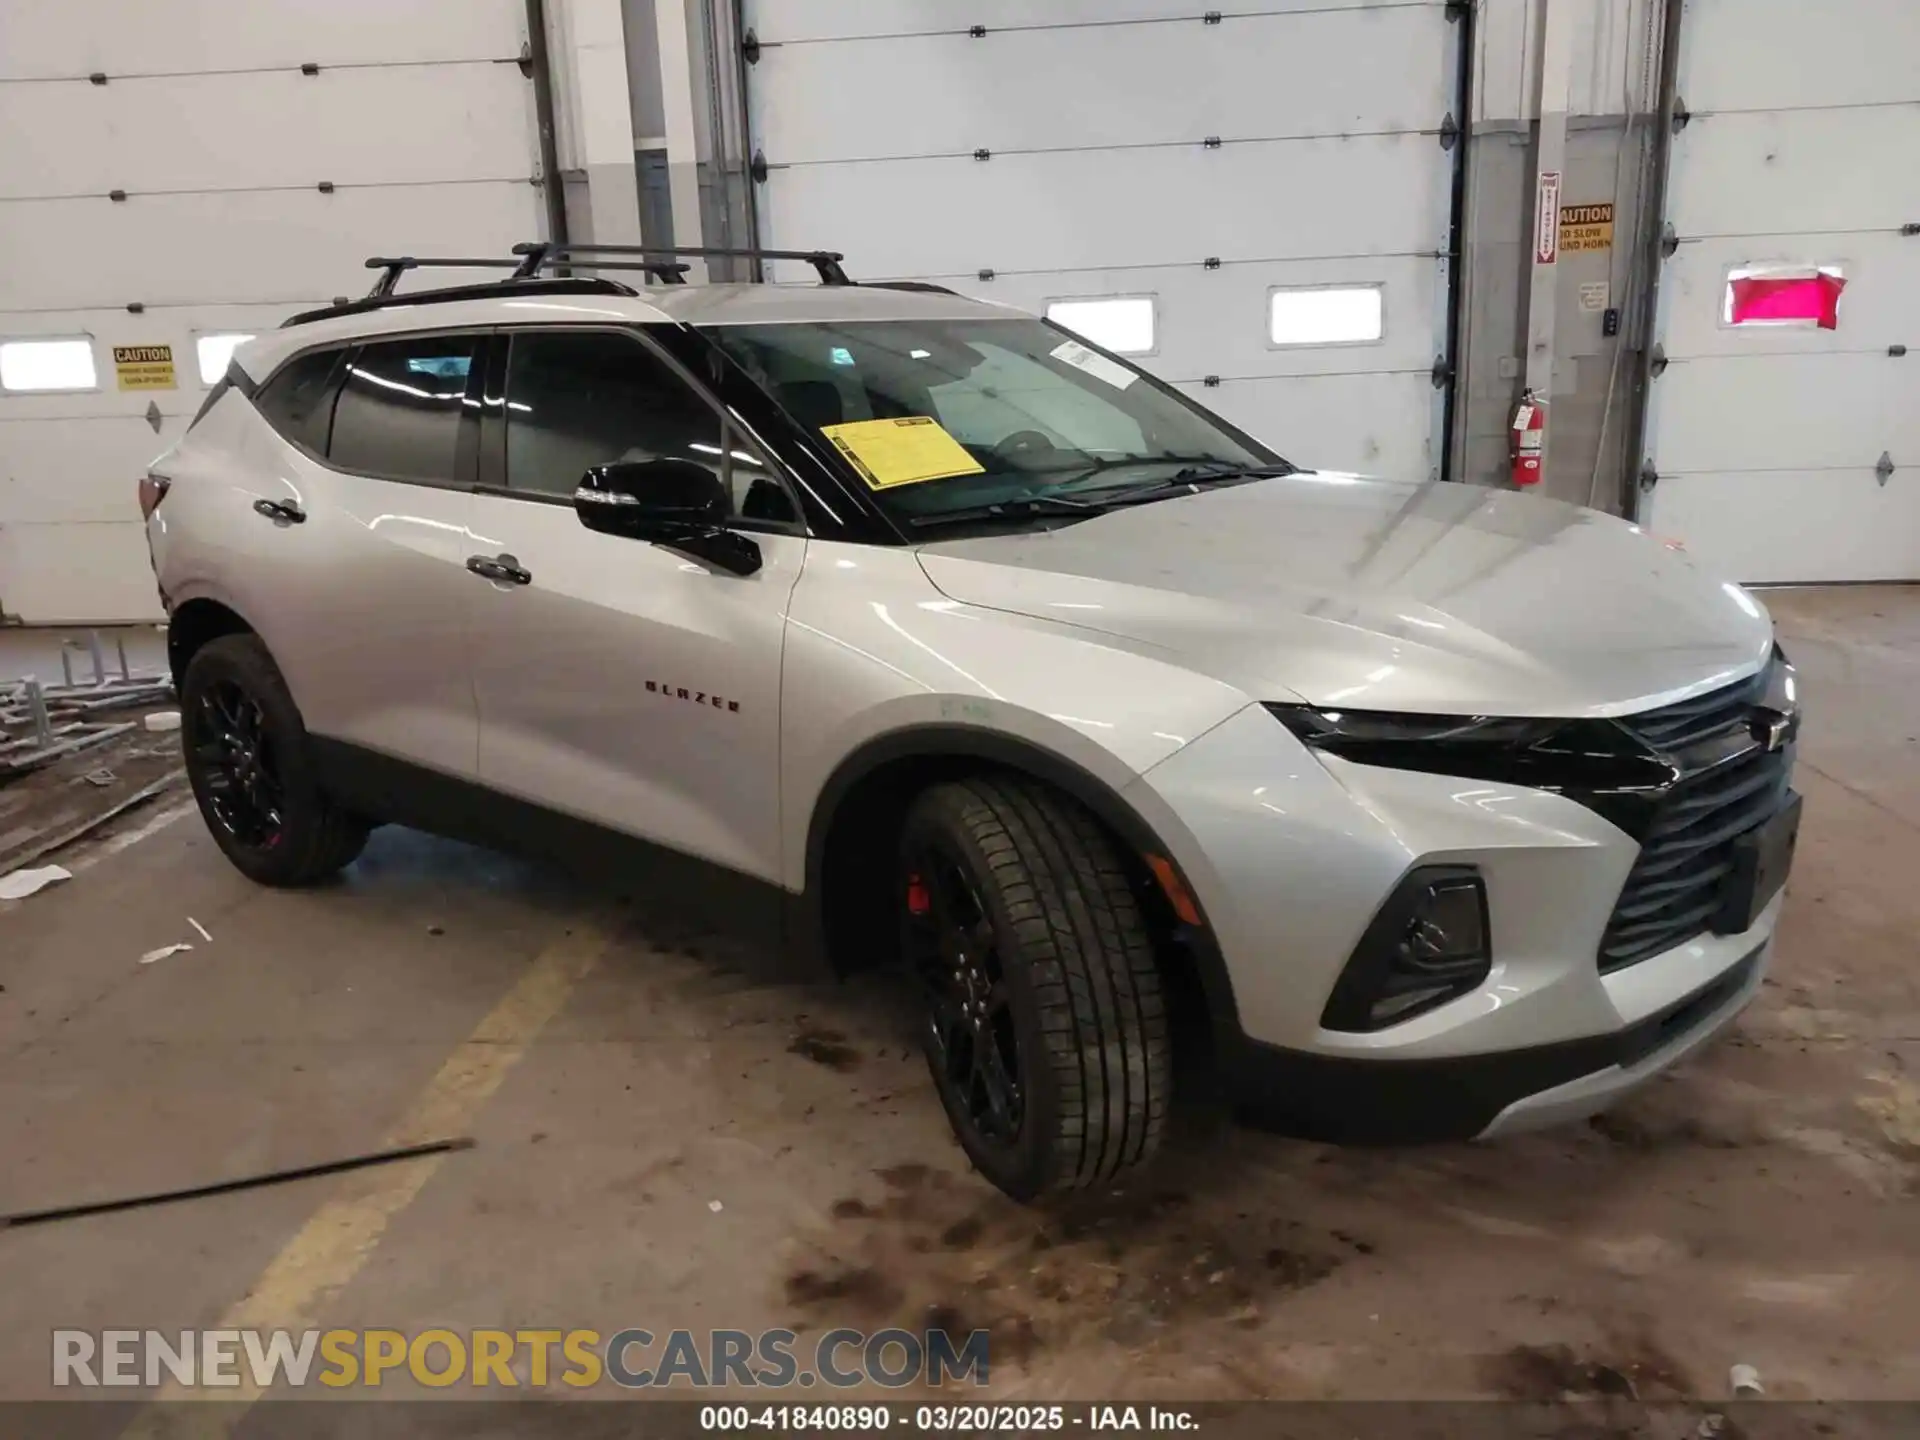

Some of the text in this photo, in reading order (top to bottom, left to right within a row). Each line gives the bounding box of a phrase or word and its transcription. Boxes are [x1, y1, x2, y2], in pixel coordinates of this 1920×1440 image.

[1559, 206, 1611, 223] AUTION
[1574, 227, 1602, 238] SLOW
[1560, 240, 1580, 251] UND
[116, 347, 170, 361] CAUTION
[645, 680, 740, 713] BLAZER
